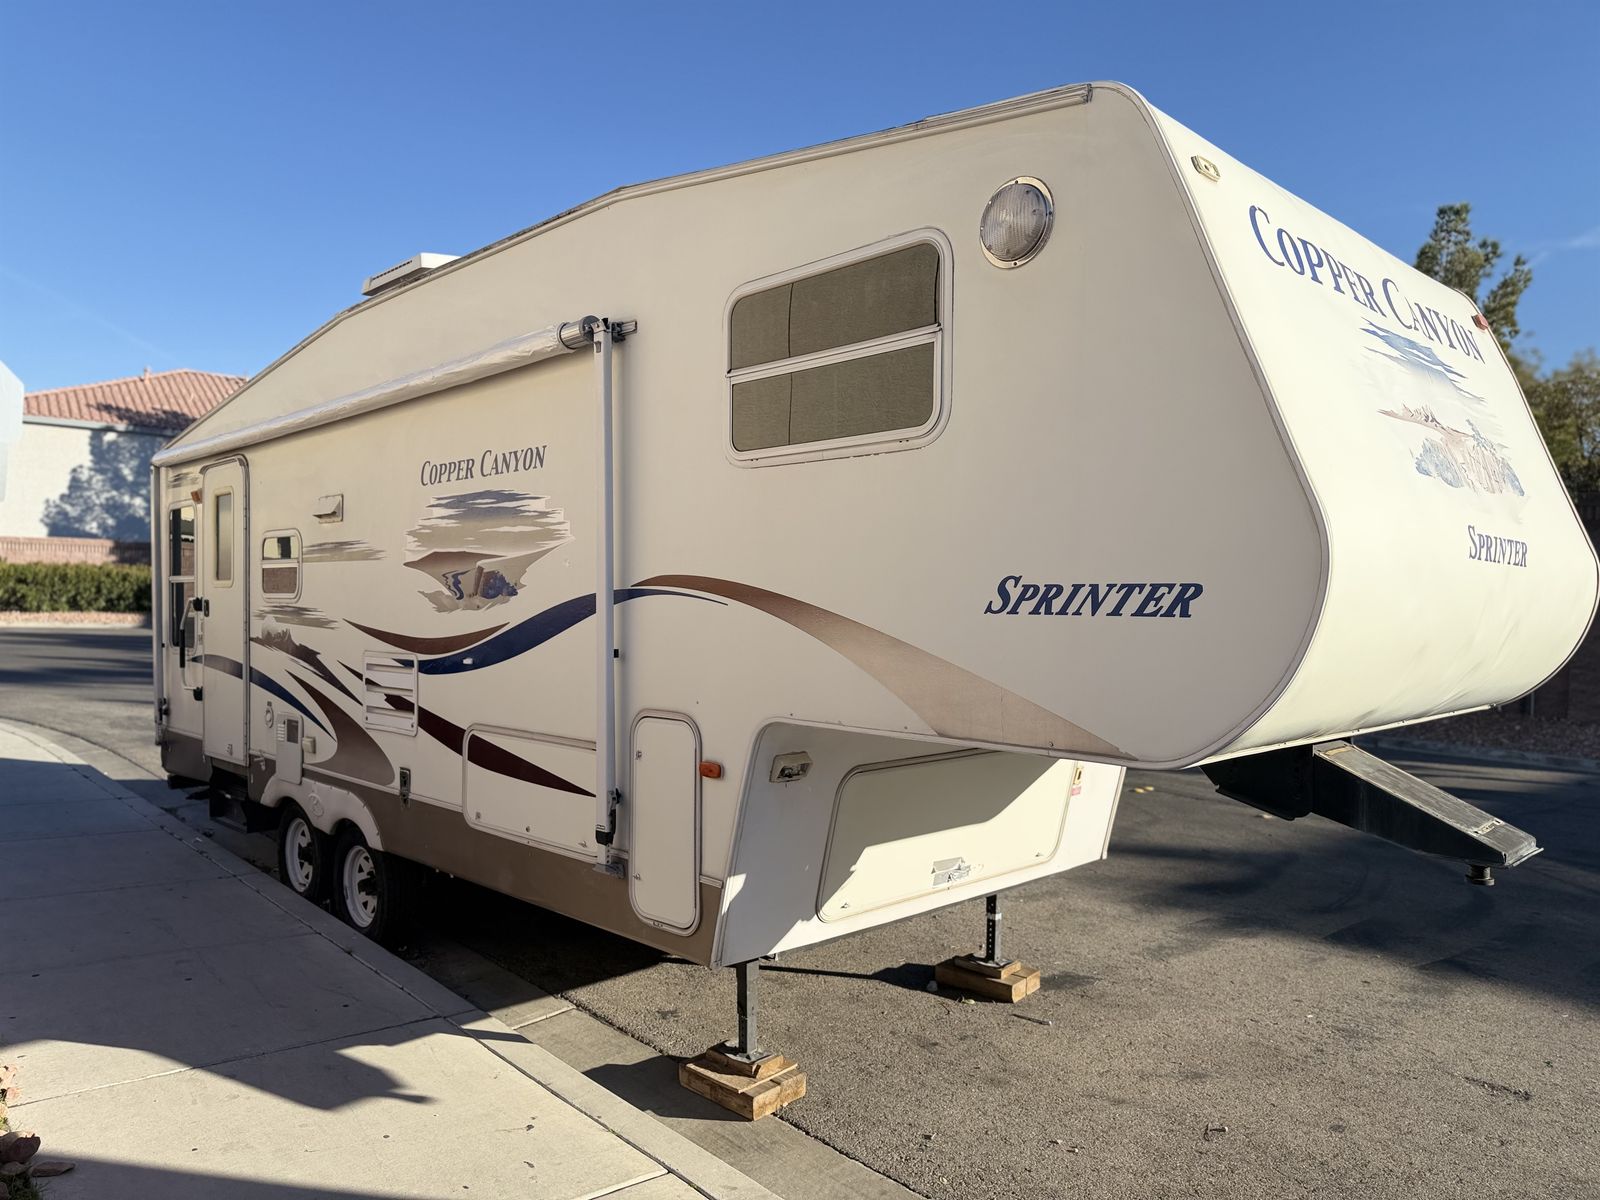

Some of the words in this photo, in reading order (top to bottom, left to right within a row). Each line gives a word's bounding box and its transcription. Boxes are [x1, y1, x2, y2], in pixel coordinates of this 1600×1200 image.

[1249, 205, 1387, 317] COPPER
[1382, 278, 1486, 364] CANYON
[421, 458, 475, 486] COPPER
[480, 445, 547, 477] CANYON
[1467, 524, 1527, 567] SPRINTER
[984, 575, 1204, 618] SPRINTER
